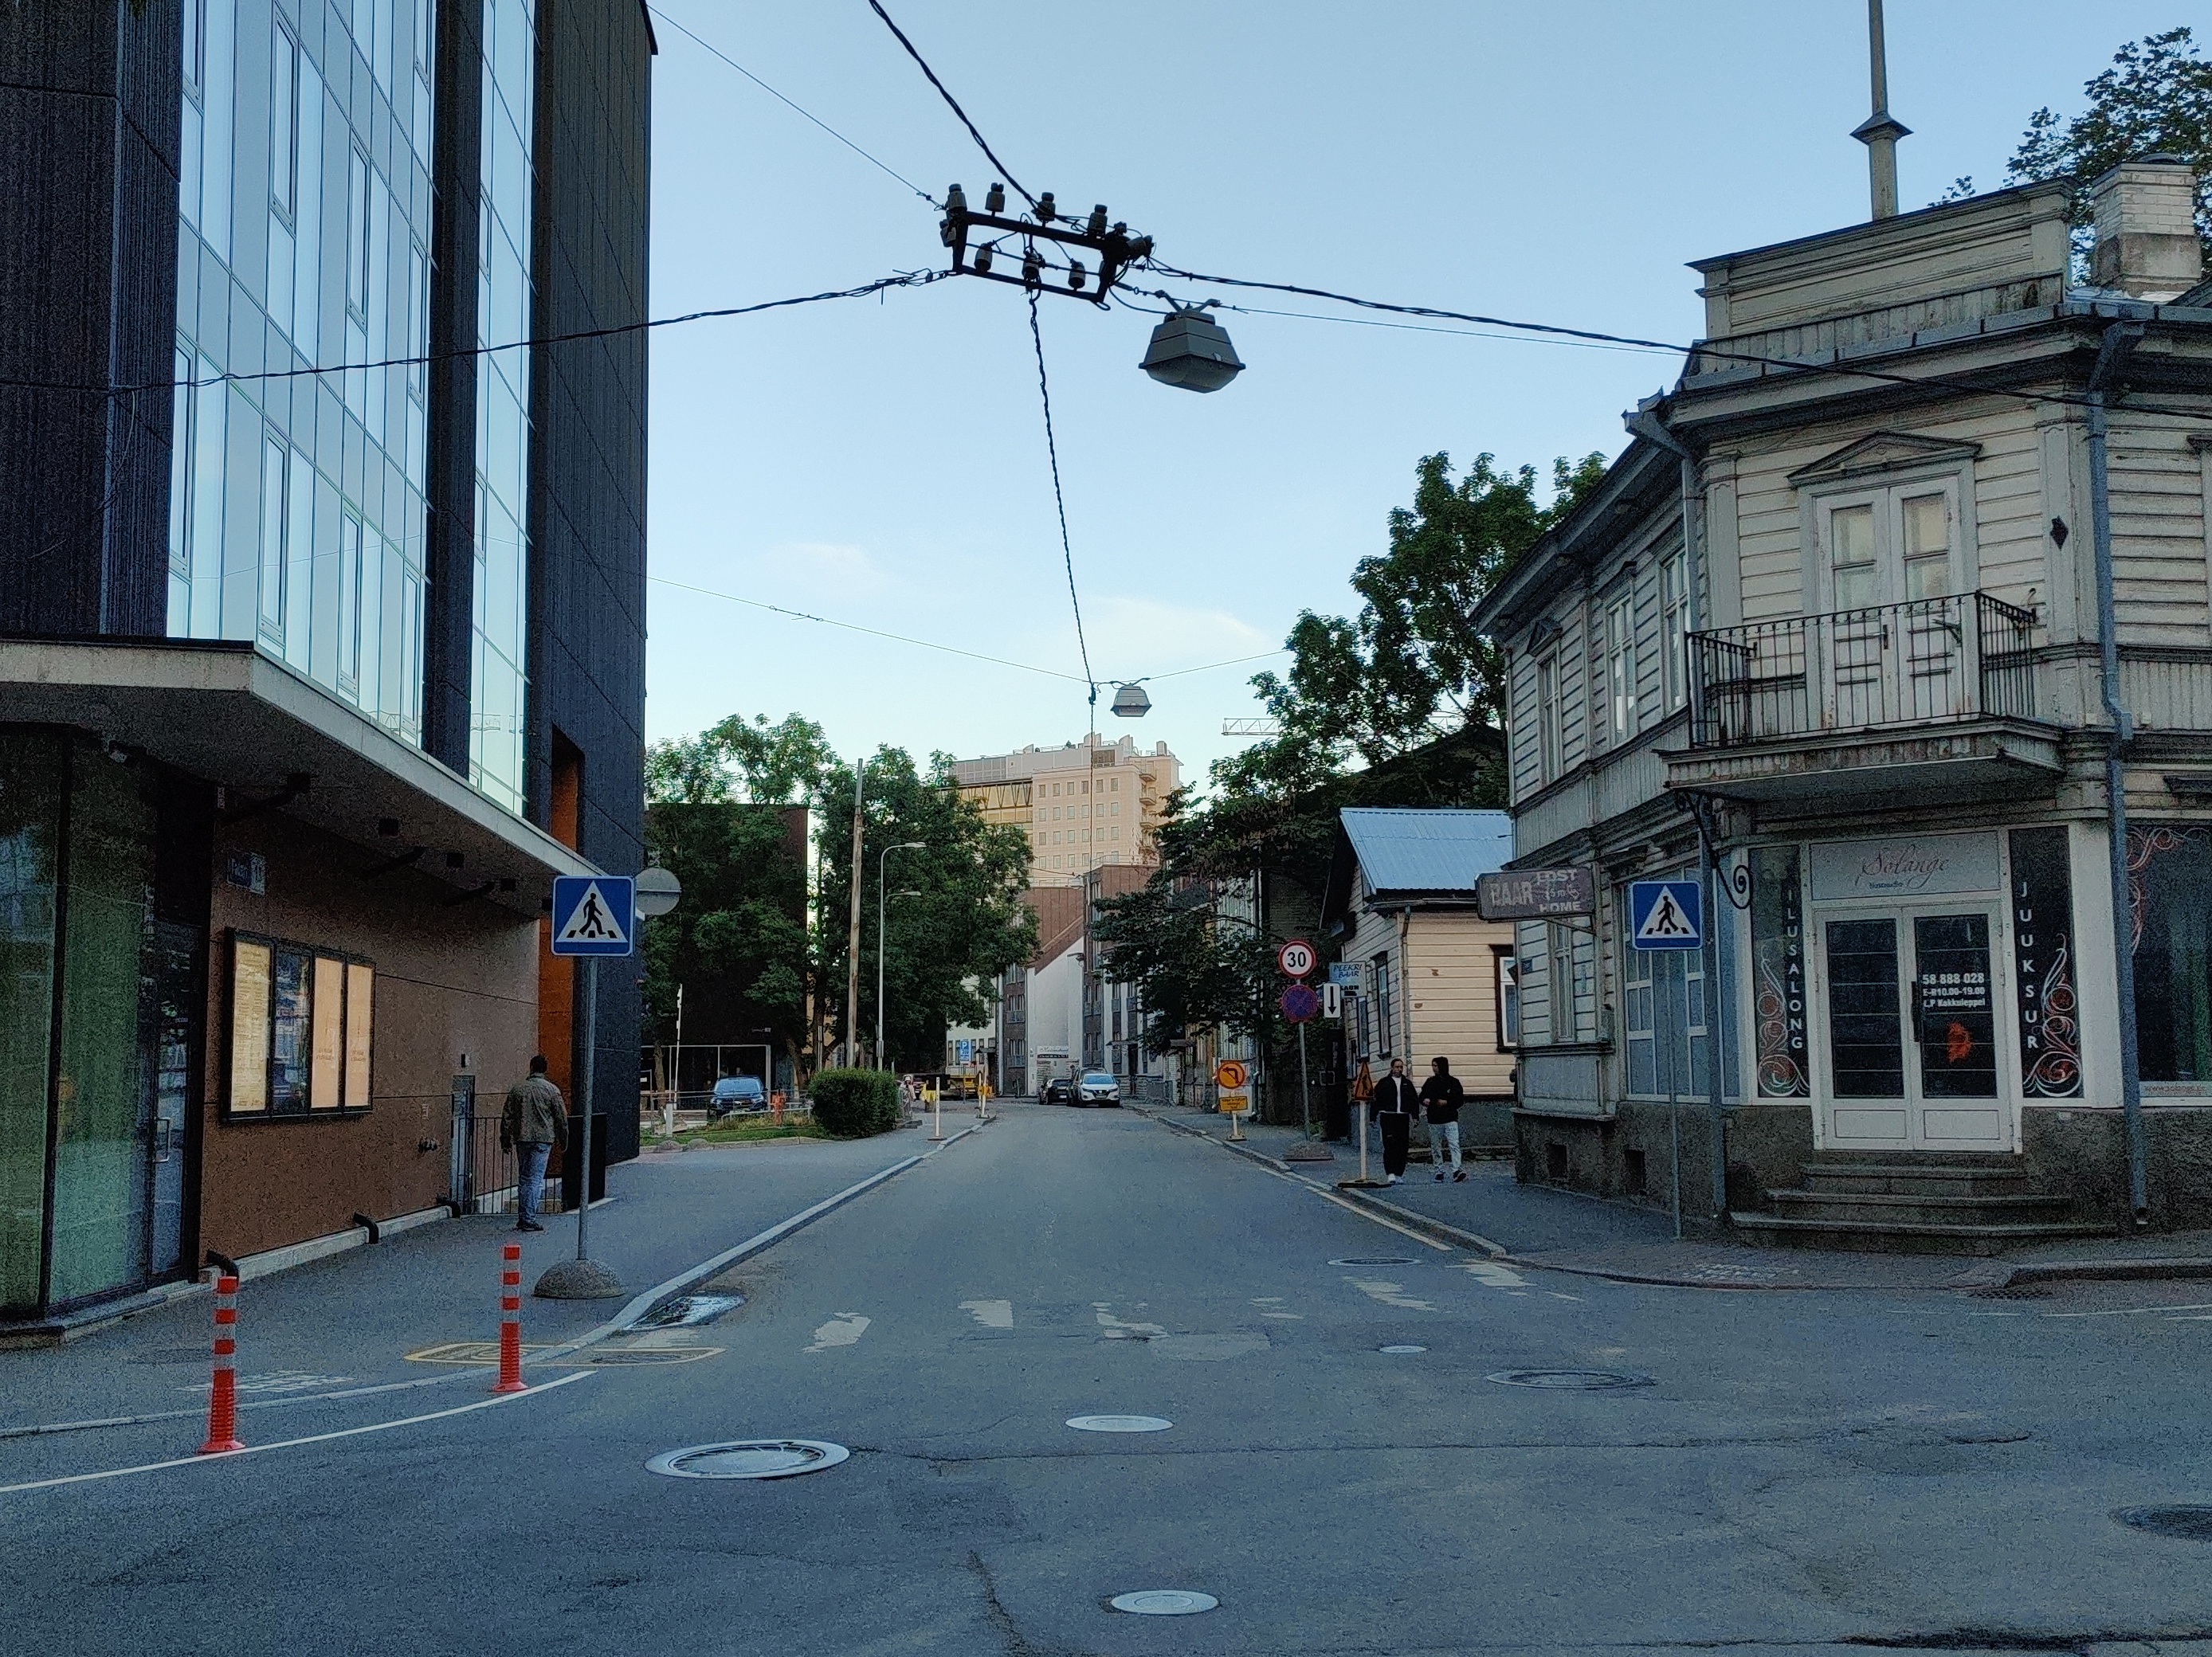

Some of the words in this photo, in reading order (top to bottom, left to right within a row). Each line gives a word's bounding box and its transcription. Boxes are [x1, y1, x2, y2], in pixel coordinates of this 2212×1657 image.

[1855, 844, 1950, 890] Solange
[1539, 901, 1583, 913] HOME
[1287, 951, 1307, 968] 30
[1786, 889, 1803, 1050] ILUSALONG
[2019, 881, 2039, 1049] JUUKSUR
[1922, 973, 1937, 985] 58
[1939, 973, 1961, 985] 888
[1963, 972, 1985, 984] 028
